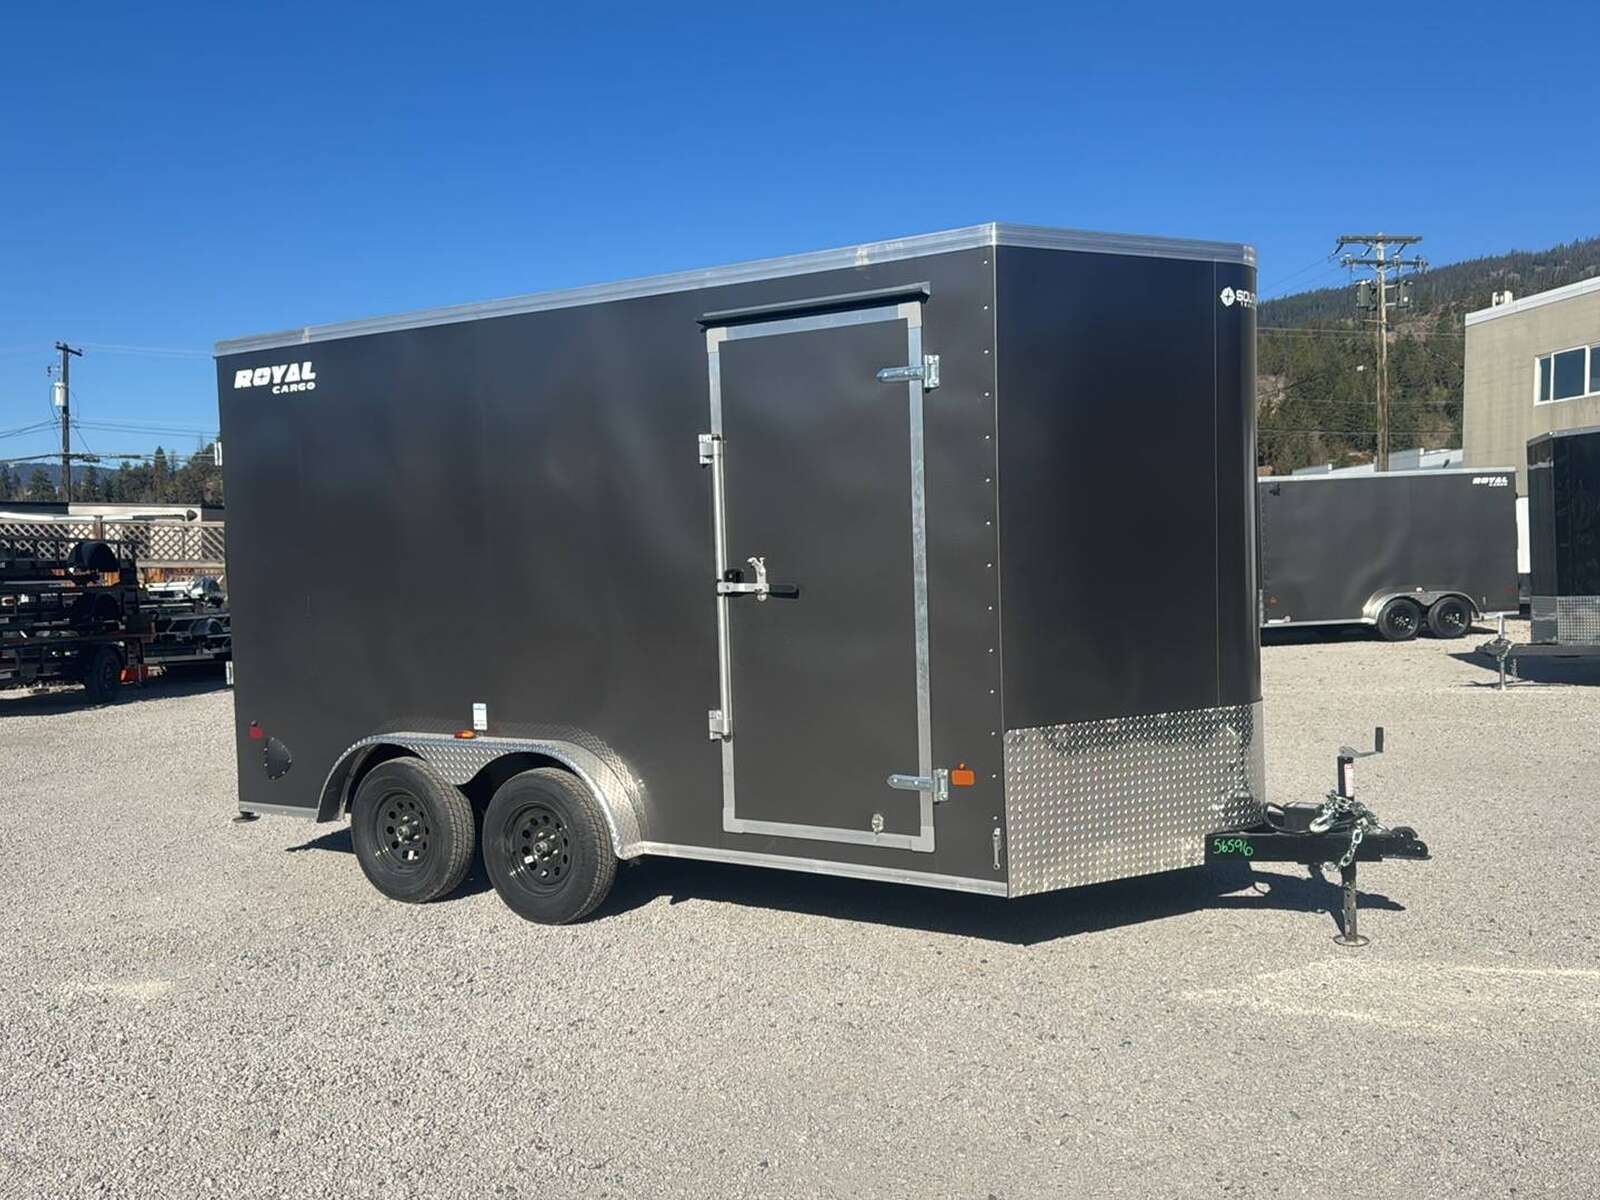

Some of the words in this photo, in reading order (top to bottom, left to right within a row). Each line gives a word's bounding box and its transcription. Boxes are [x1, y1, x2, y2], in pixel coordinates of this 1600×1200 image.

[234, 361, 316, 389] ROYAL
[272, 382, 316, 394] CARGO
[1213, 838, 1254, 856] 56596
